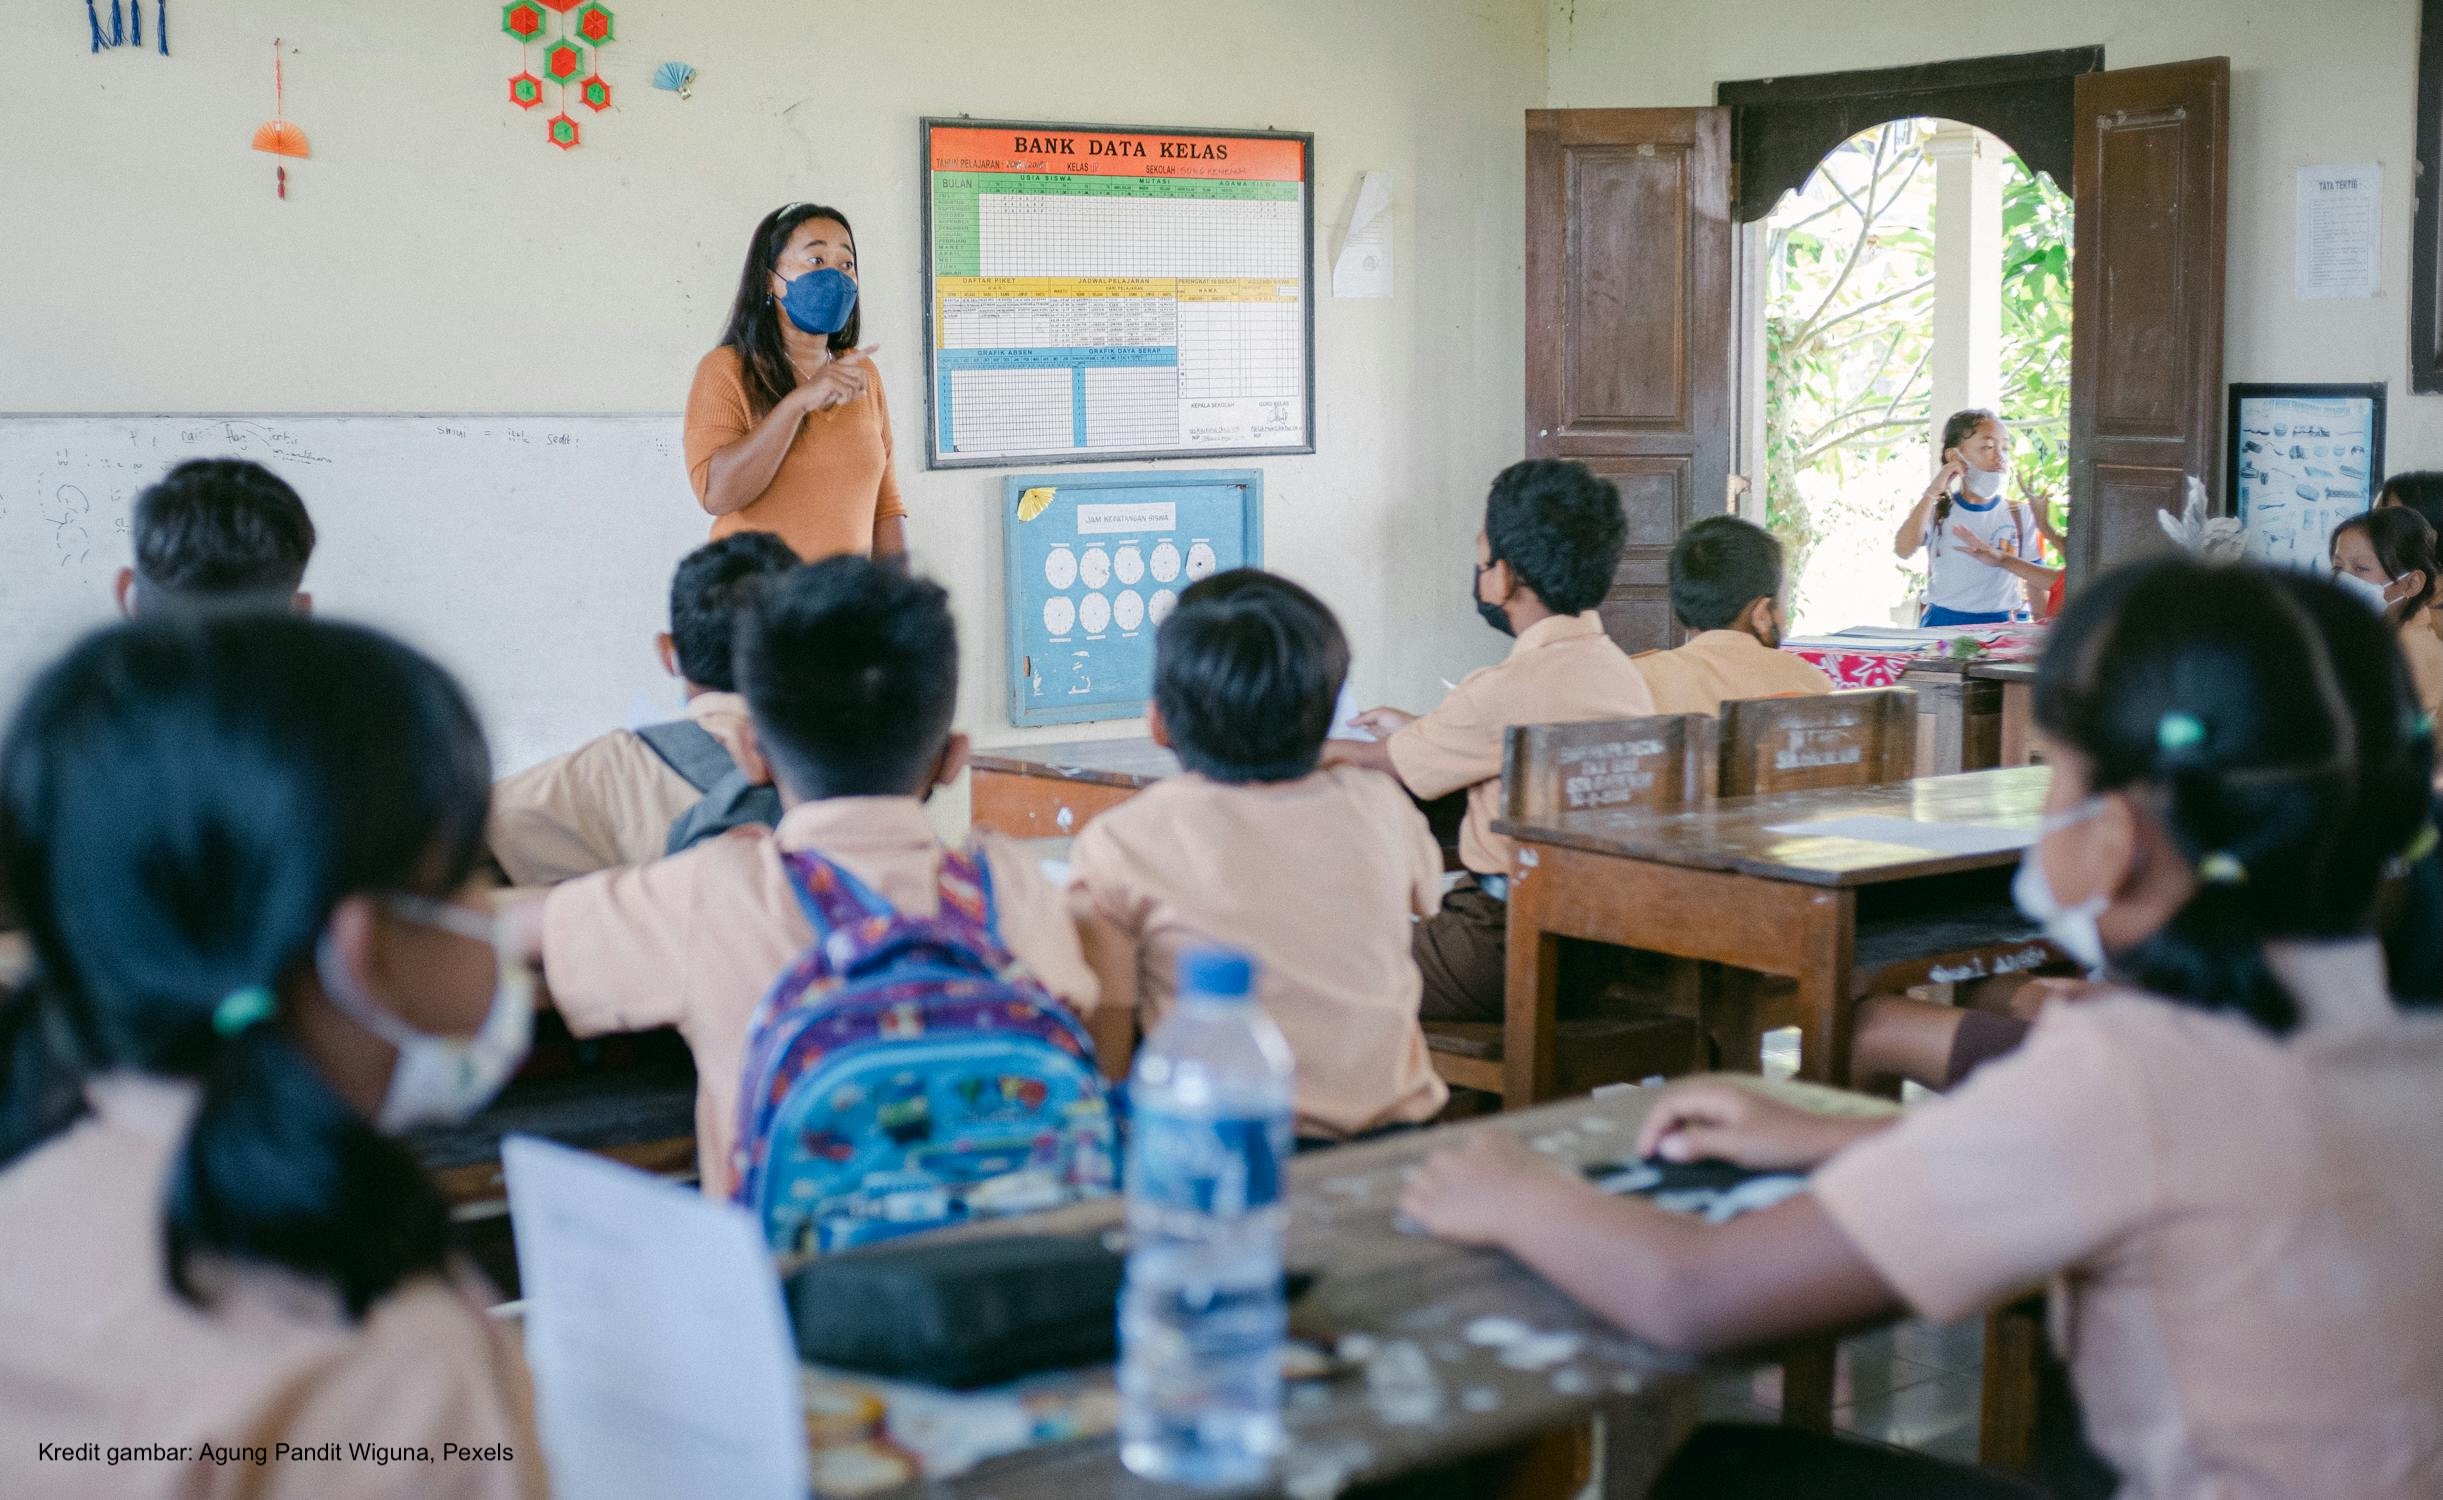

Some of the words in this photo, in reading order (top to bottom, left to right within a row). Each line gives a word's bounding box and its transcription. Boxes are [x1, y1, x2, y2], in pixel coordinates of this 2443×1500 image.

[1013, 136, 1076, 155] BANK
[1088, 138, 1147, 158] DATA
[1160, 141, 1228, 160] KELAS
[936, 158, 959, 168] TAHUN
[960, 159, 1000, 169] PELAJARAN
[1067, 162, 1089, 172] KELAS
[1145, 164, 1176, 175] SEKOLAH
[942, 178, 973, 189] BULAN
[2318, 181, 2335, 191] TATA
